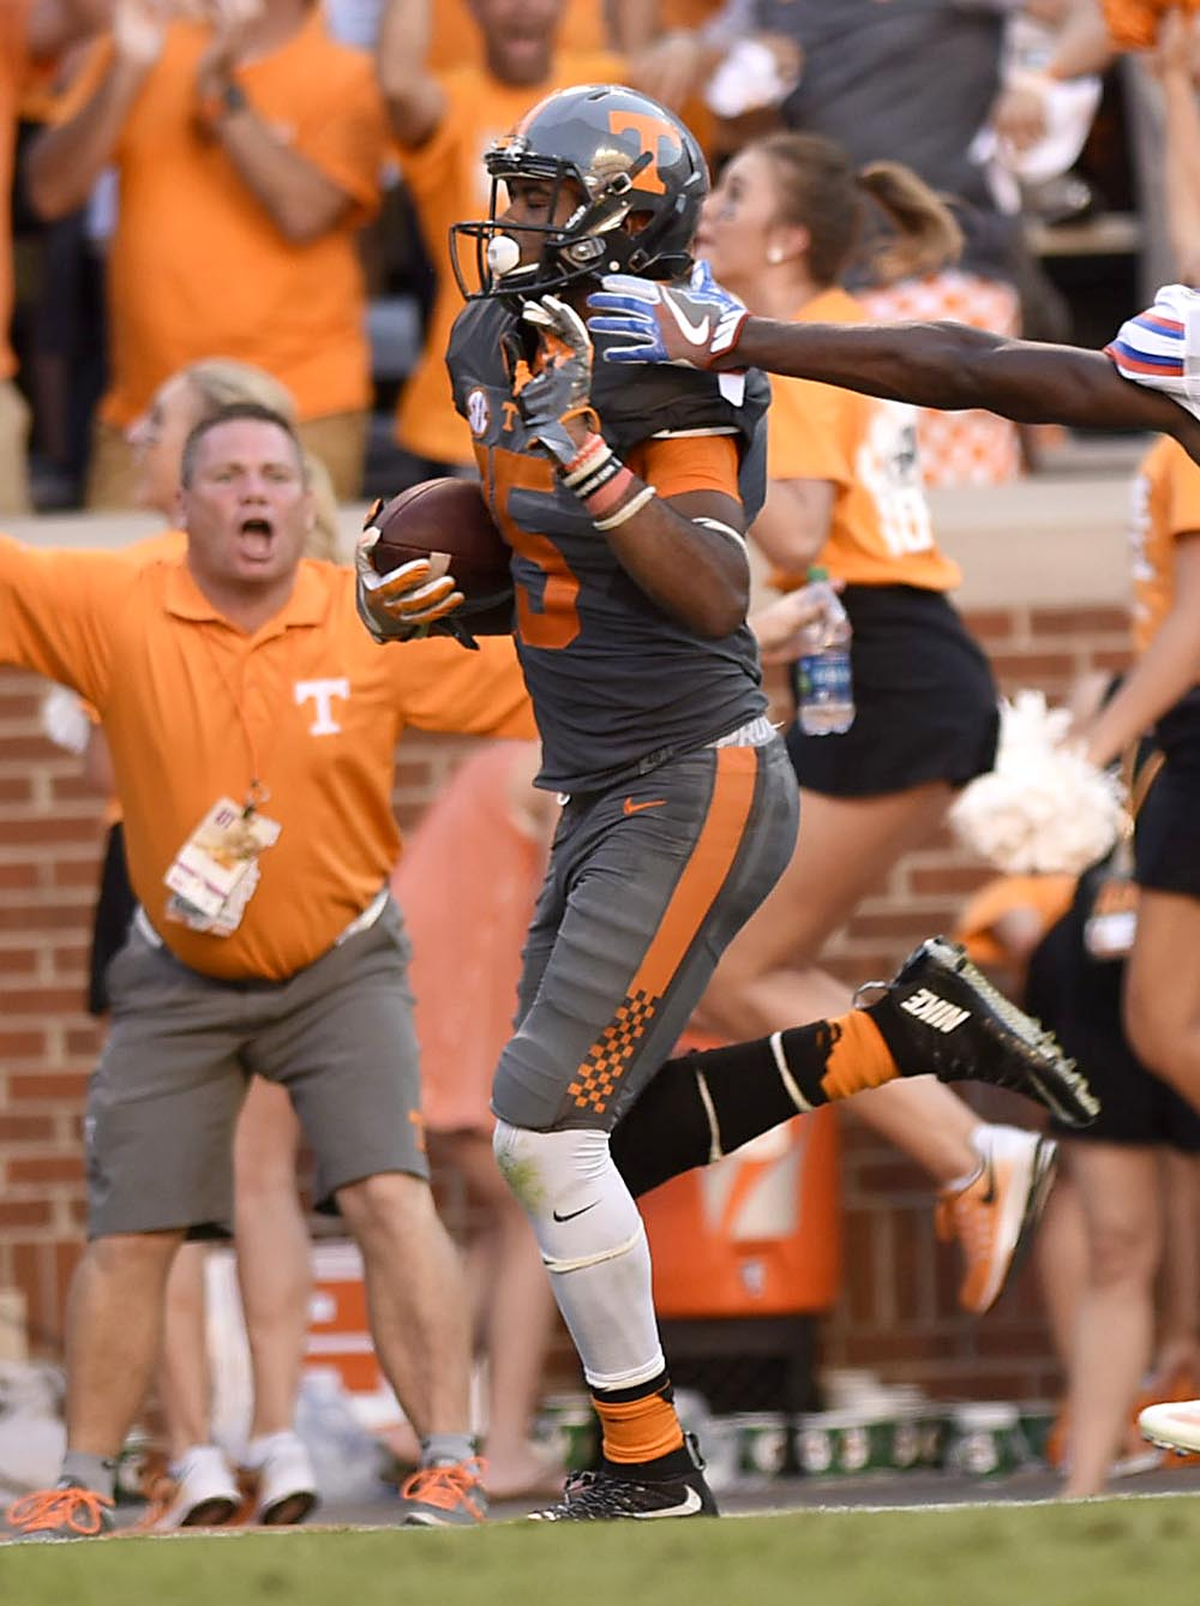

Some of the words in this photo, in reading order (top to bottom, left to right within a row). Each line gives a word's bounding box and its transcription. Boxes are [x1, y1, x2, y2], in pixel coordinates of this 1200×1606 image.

[609, 110, 682, 195] T
[502, 401, 519, 432] T
[294, 679, 349, 736] T
[900, 988, 971, 1033] NIKE
